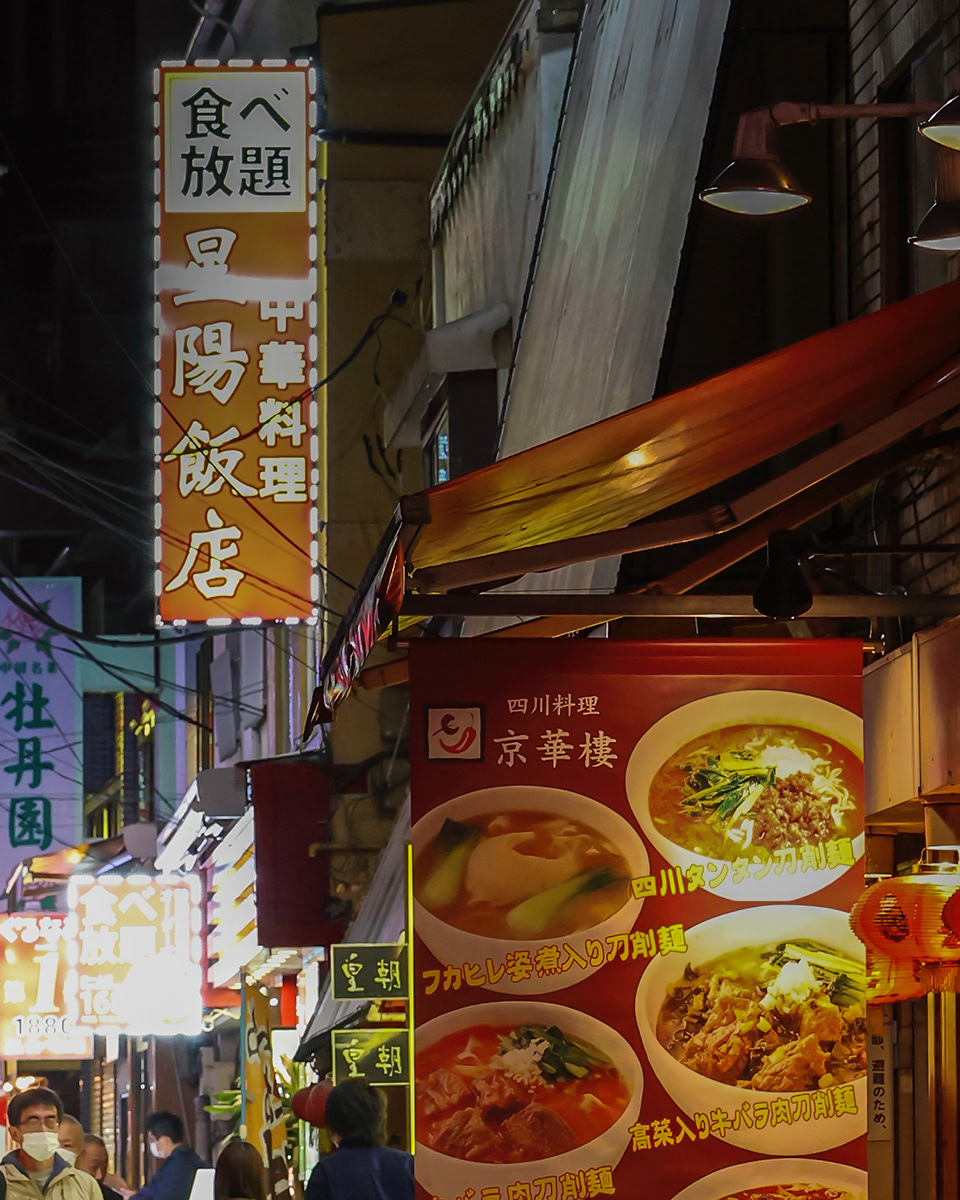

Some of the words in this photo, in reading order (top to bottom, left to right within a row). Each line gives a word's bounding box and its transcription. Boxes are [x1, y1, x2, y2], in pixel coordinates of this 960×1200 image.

[180, 86, 291, 140] 食べ
[180, 145, 292, 198] 放題
[257, 290, 308, 503] 中華料理
[506, 693, 601, 717] 四川料理
[0, 680, 55, 851] 牡丹園
[493, 728, 619, 769] 京華樓
[340, 952, 403, 993] 皇朝
